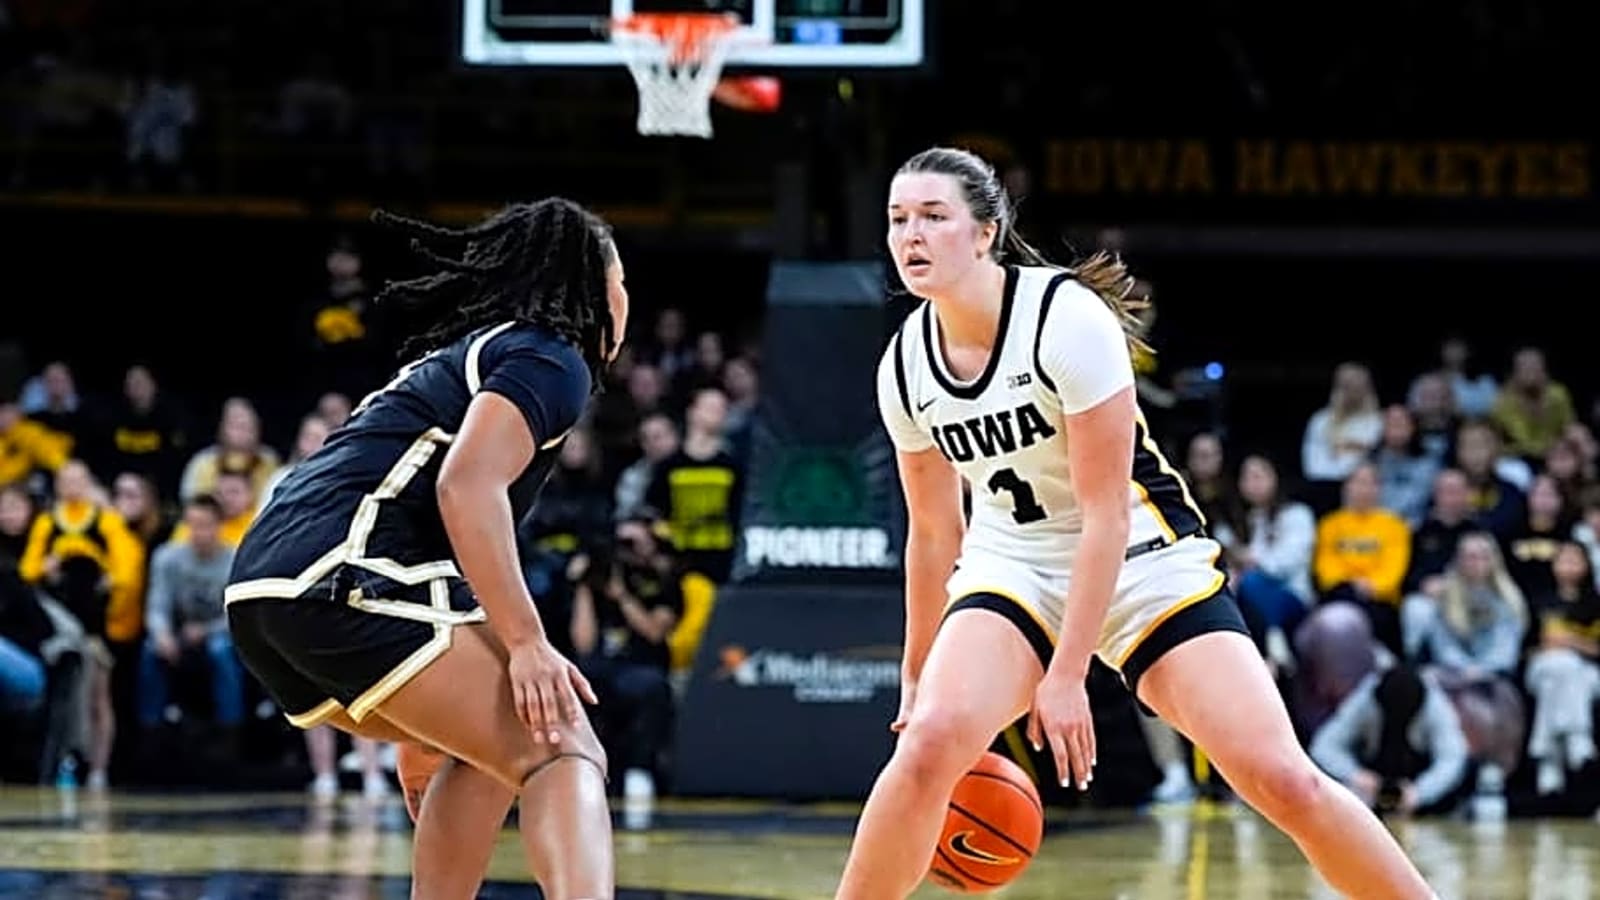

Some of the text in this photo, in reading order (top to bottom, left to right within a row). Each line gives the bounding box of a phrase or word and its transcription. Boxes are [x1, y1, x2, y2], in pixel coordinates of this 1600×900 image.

[1045, 138, 1590, 199] IOWA HAWKEYES
[931, 402, 1056, 462] IOWA
[988, 467, 1047, 524] 1
